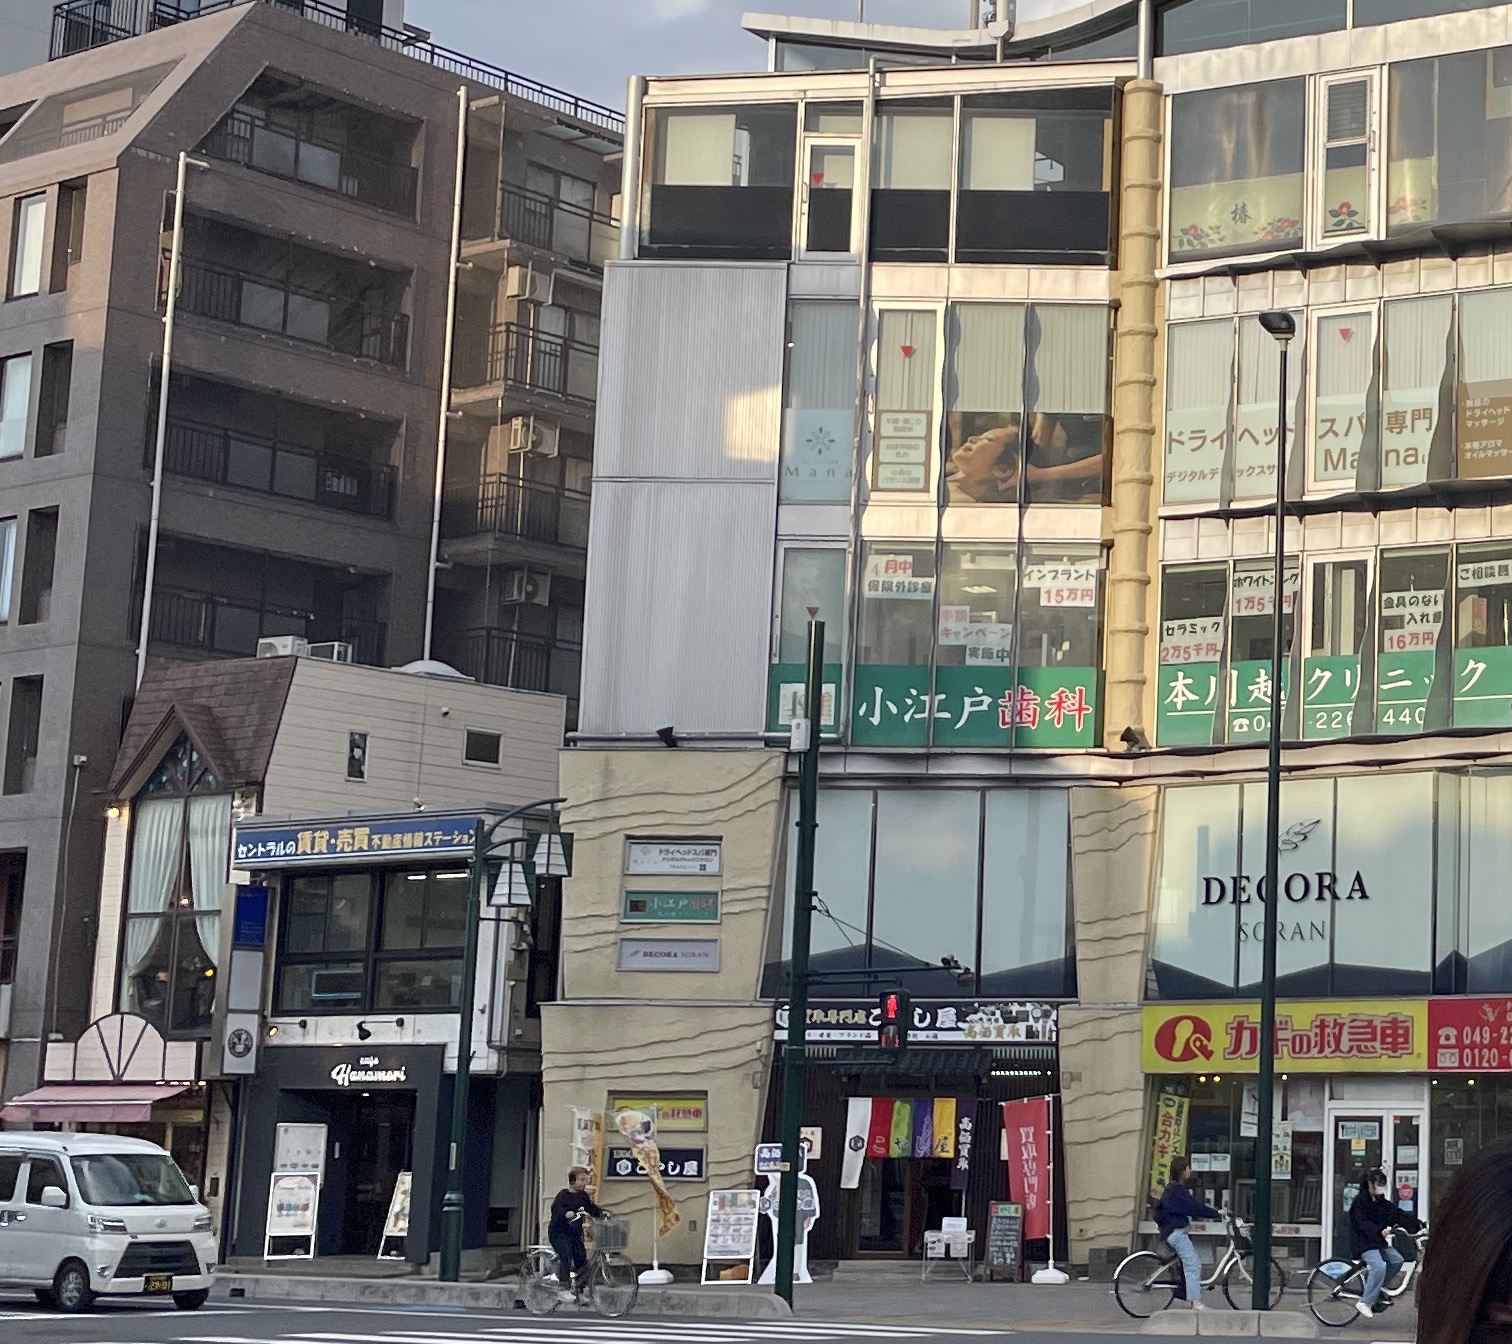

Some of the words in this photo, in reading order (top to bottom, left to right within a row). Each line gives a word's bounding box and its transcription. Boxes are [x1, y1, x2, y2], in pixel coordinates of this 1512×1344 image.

[1231, 202, 1251, 224] 椿
[872, 559, 912, 575] 4月中
[1025, 569, 1095, 581] インプラント
[1044, 587, 1094, 604] 15万円
[1165, 621, 1221, 636] セラミック
[1388, 631, 1434, 650] 16万円
[1160, 642, 1220, 663] 2万5千円
[858, 685, 1093, 733] 小江戸歯科
[1224, 1012, 1414, 1060] カギの救急車
